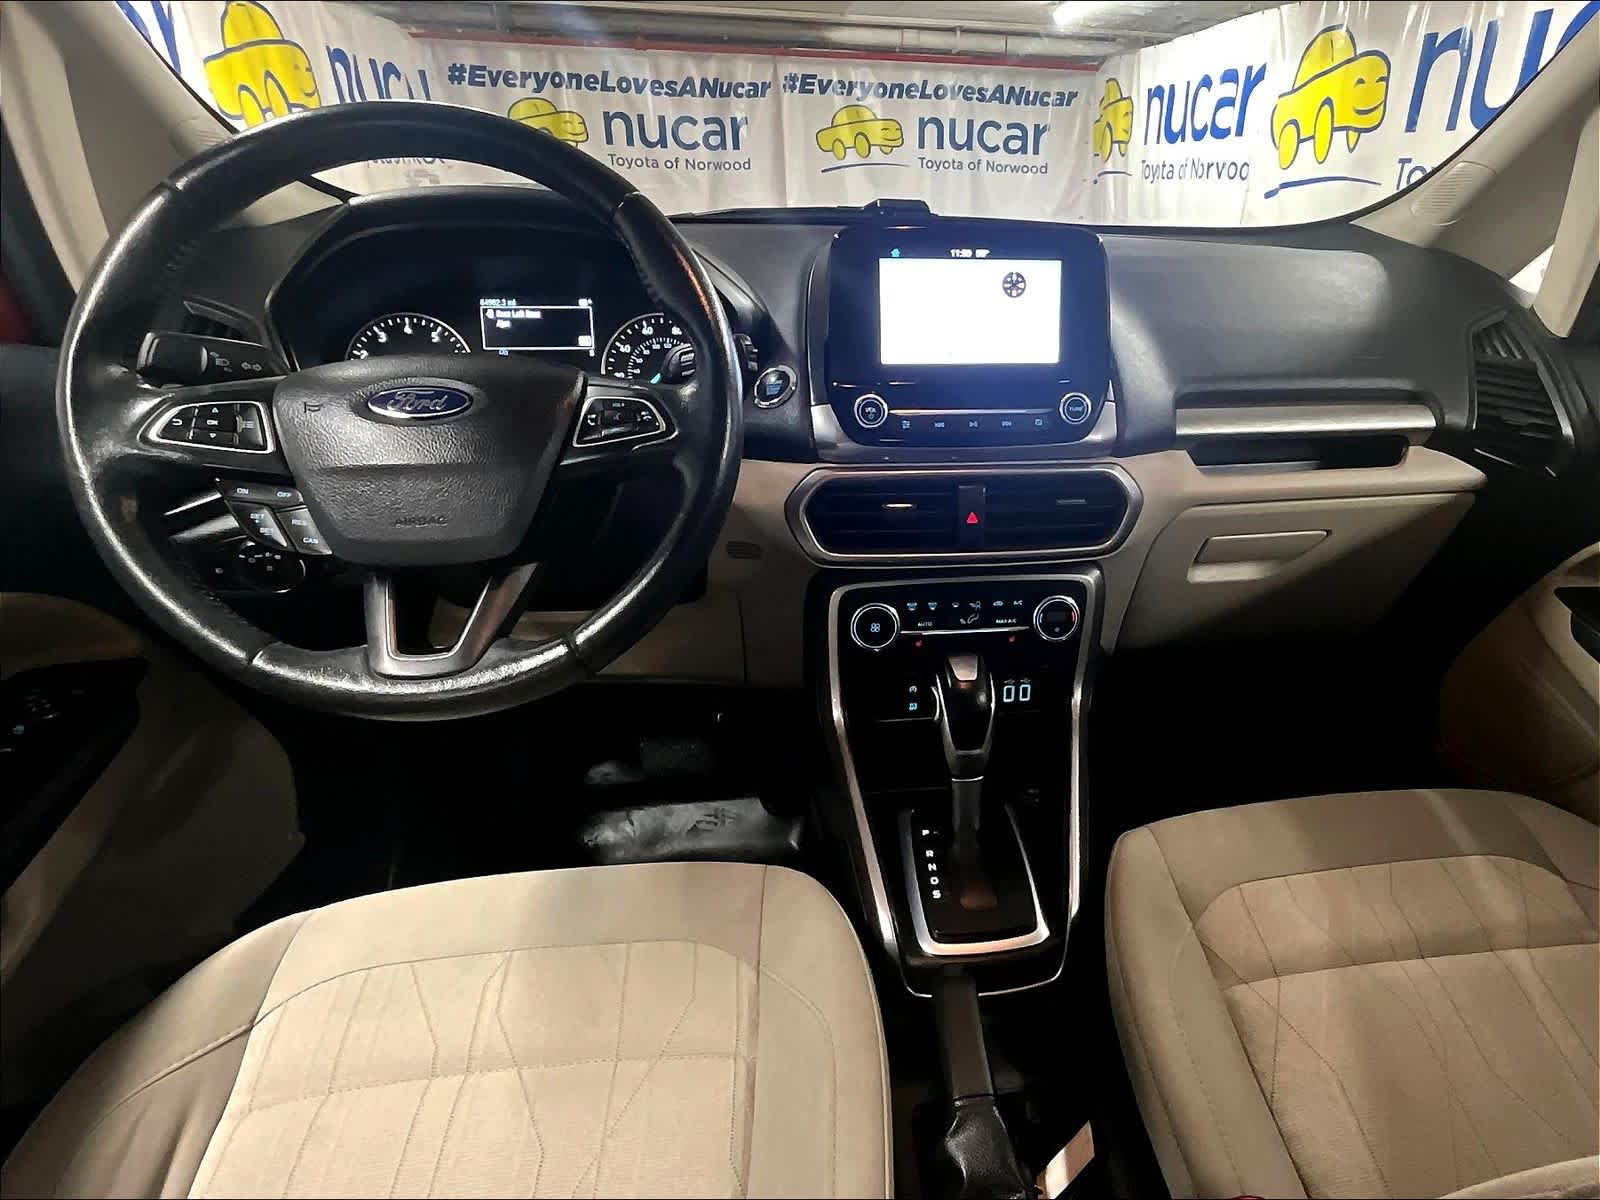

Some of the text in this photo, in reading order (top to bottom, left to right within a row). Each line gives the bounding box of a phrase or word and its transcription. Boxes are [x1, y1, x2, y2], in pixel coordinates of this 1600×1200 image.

[447, 63, 771, 99] #EveryoneLovesANucar
[783, 72, 1078, 107] #EveryoneLovesANucar
[1143, 62, 1267, 146] nucar
[602, 110, 748, 151] nucar
[917, 115, 1050, 156] nucar
[608, 153, 752, 171] Toyota of Norwood
[917, 157, 1048, 175] Toyota of Norwood
[386, 391, 449, 411] Ford
